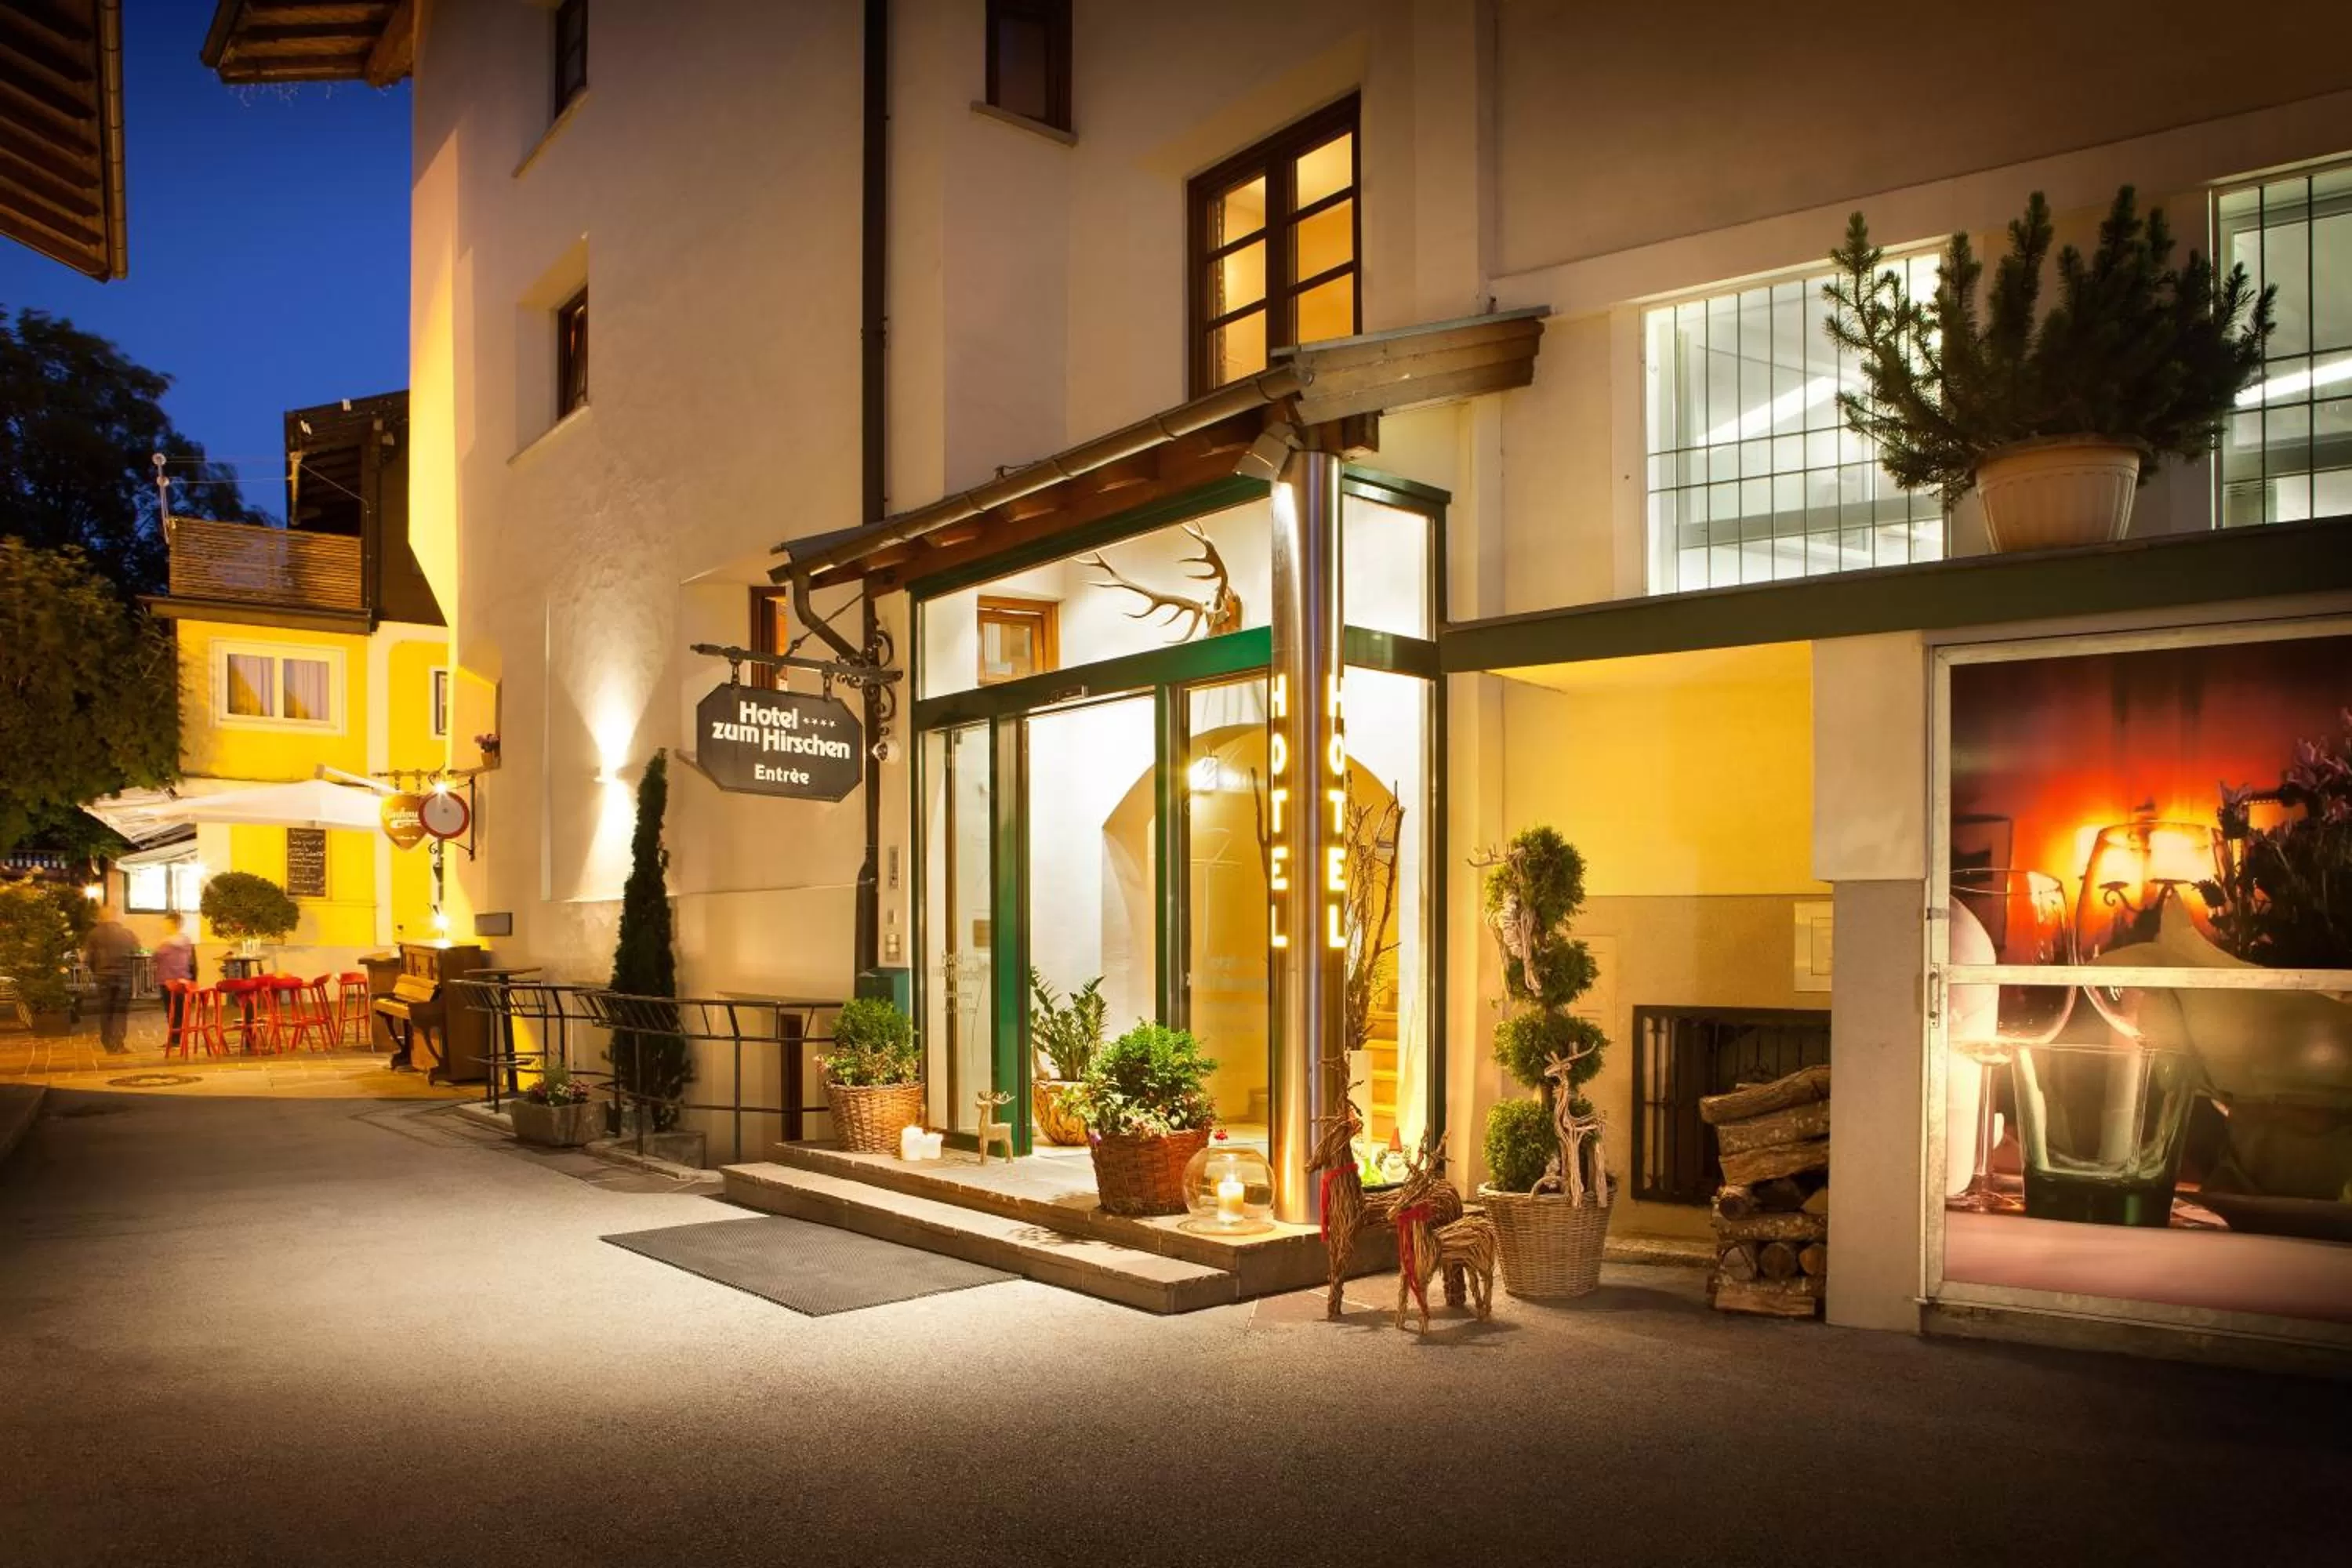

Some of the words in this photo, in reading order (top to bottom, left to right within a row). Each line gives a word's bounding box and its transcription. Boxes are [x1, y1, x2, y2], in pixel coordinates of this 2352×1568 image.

[712, 721, 759, 743] zum
[763, 728, 851, 759] Hirschen
[739, 701, 798, 729] Hotel
[1271, 673, 1288, 948] HOTEL
[1327, 673, 1347, 949] HOTEL
